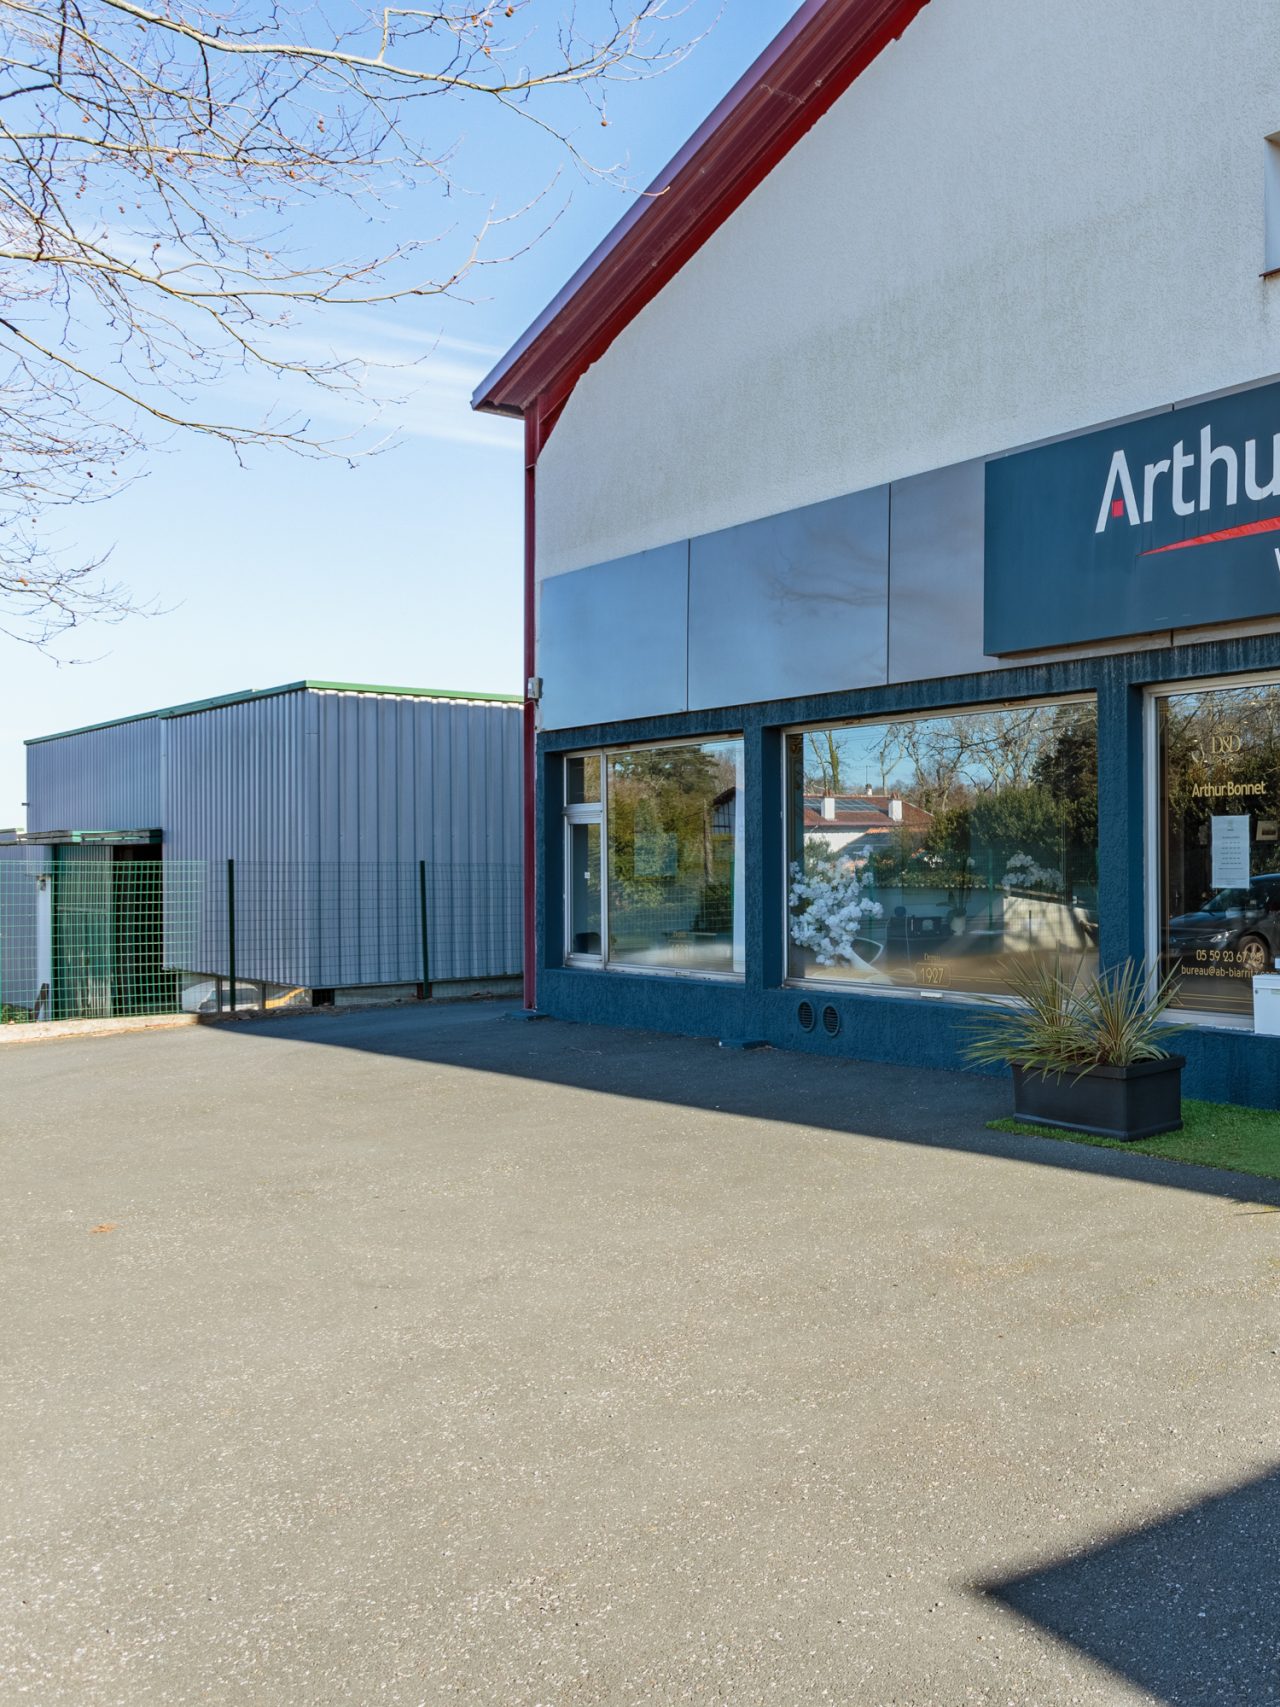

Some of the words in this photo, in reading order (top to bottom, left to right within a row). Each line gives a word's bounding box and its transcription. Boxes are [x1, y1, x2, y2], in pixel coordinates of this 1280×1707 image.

[1192, 783, 1227, 797] Arthur
[1227, 781, 1267, 796] Bonnet
[1196, 949, 1207, 961] 05
[1209, 949, 1221, 961] 59
[1222, 950, 1234, 962] 23
[920, 967, 944, 984] 1927
[1181, 964, 1278, 979] bureau@ab-biarritz
